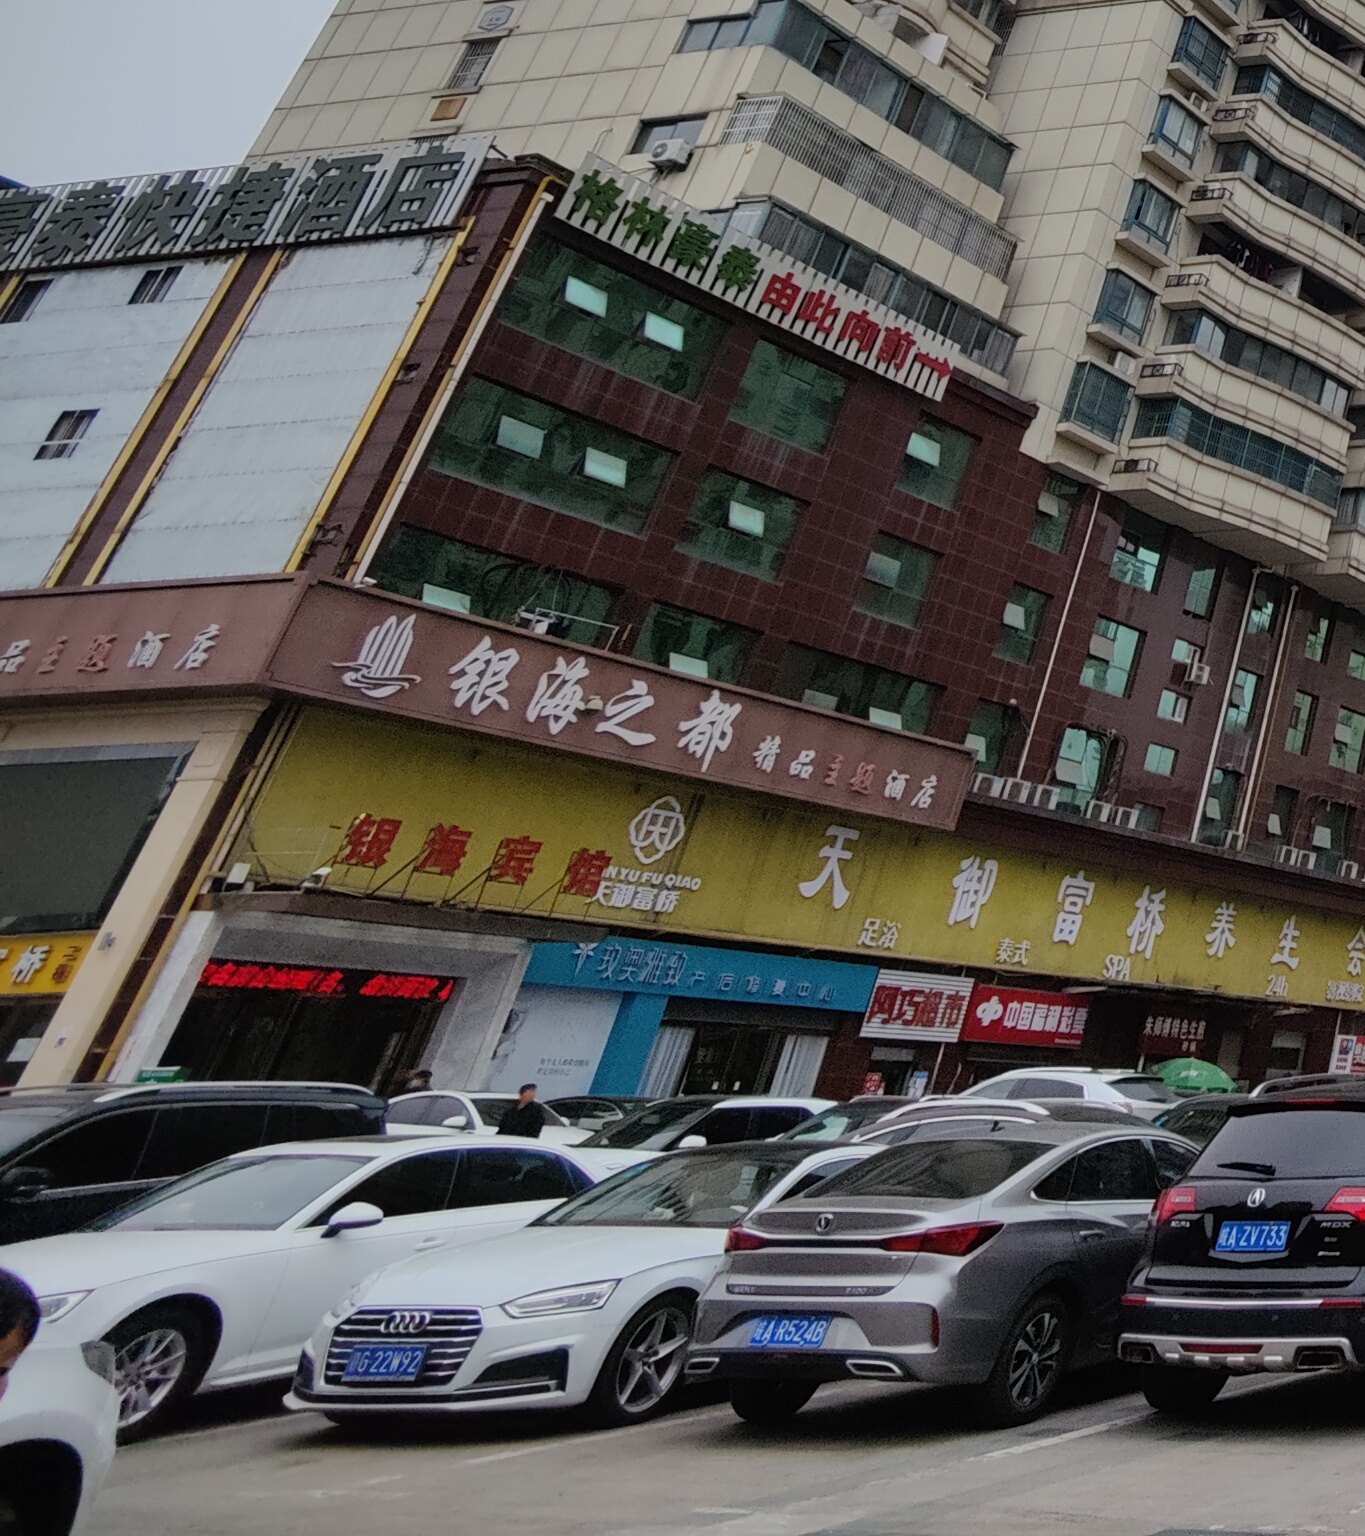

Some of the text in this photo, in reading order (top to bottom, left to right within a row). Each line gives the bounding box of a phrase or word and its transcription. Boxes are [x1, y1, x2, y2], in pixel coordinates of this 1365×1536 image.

[574, 168, 760, 292] 格林豪泰
[760, 271, 915, 372] 由此向前
[449, 635, 940, 811] 银海之都 精品主题酒店
[344, 813, 614, 897] 银海宾馆
[592, 881, 679, 914] 天御富桥
[858, 918, 902, 949] 足浴
[996, 937, 1030, 966] 泰式
[1103, 954, 1132, 982] SPA
[690, 970, 837, 1002] 产后修复中心
[1003, 1000, 1088, 1034] 中国福利彩票
